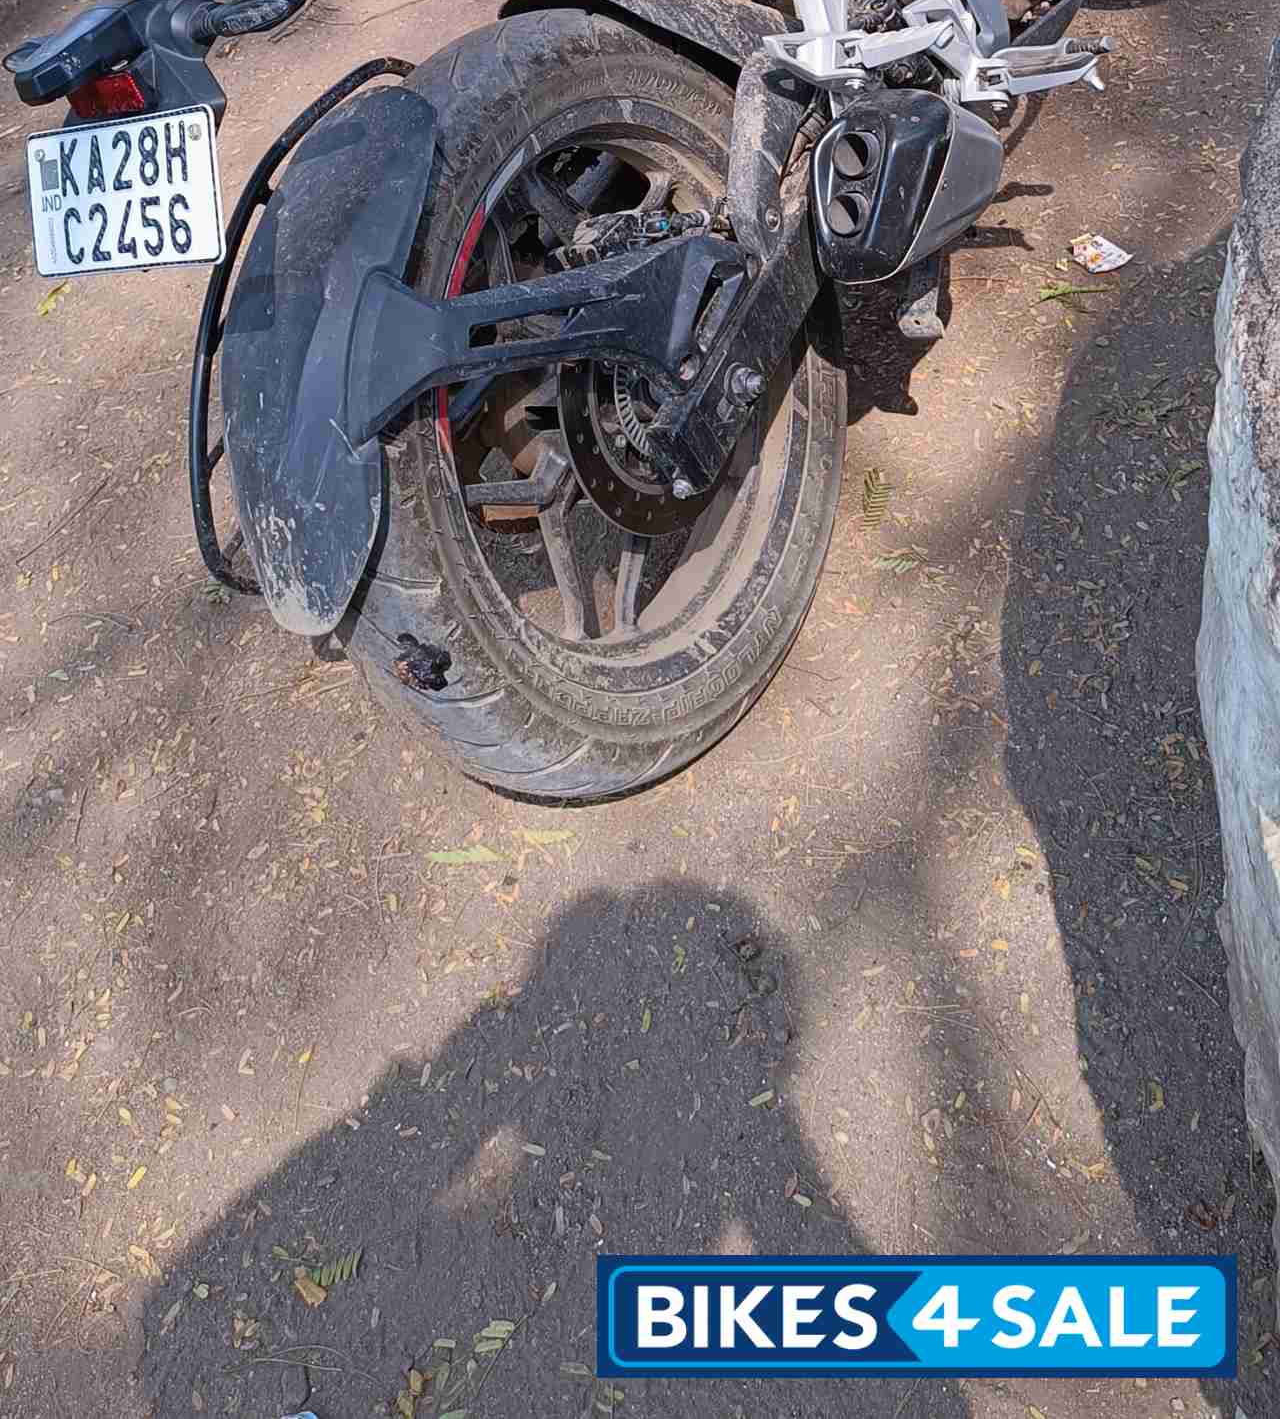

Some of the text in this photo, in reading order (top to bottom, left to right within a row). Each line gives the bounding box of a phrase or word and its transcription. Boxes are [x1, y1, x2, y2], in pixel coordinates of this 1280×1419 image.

[59, 120, 189, 197] KA28H
[41, 194, 62, 213] IND
[63, 193, 193, 265] C2456
